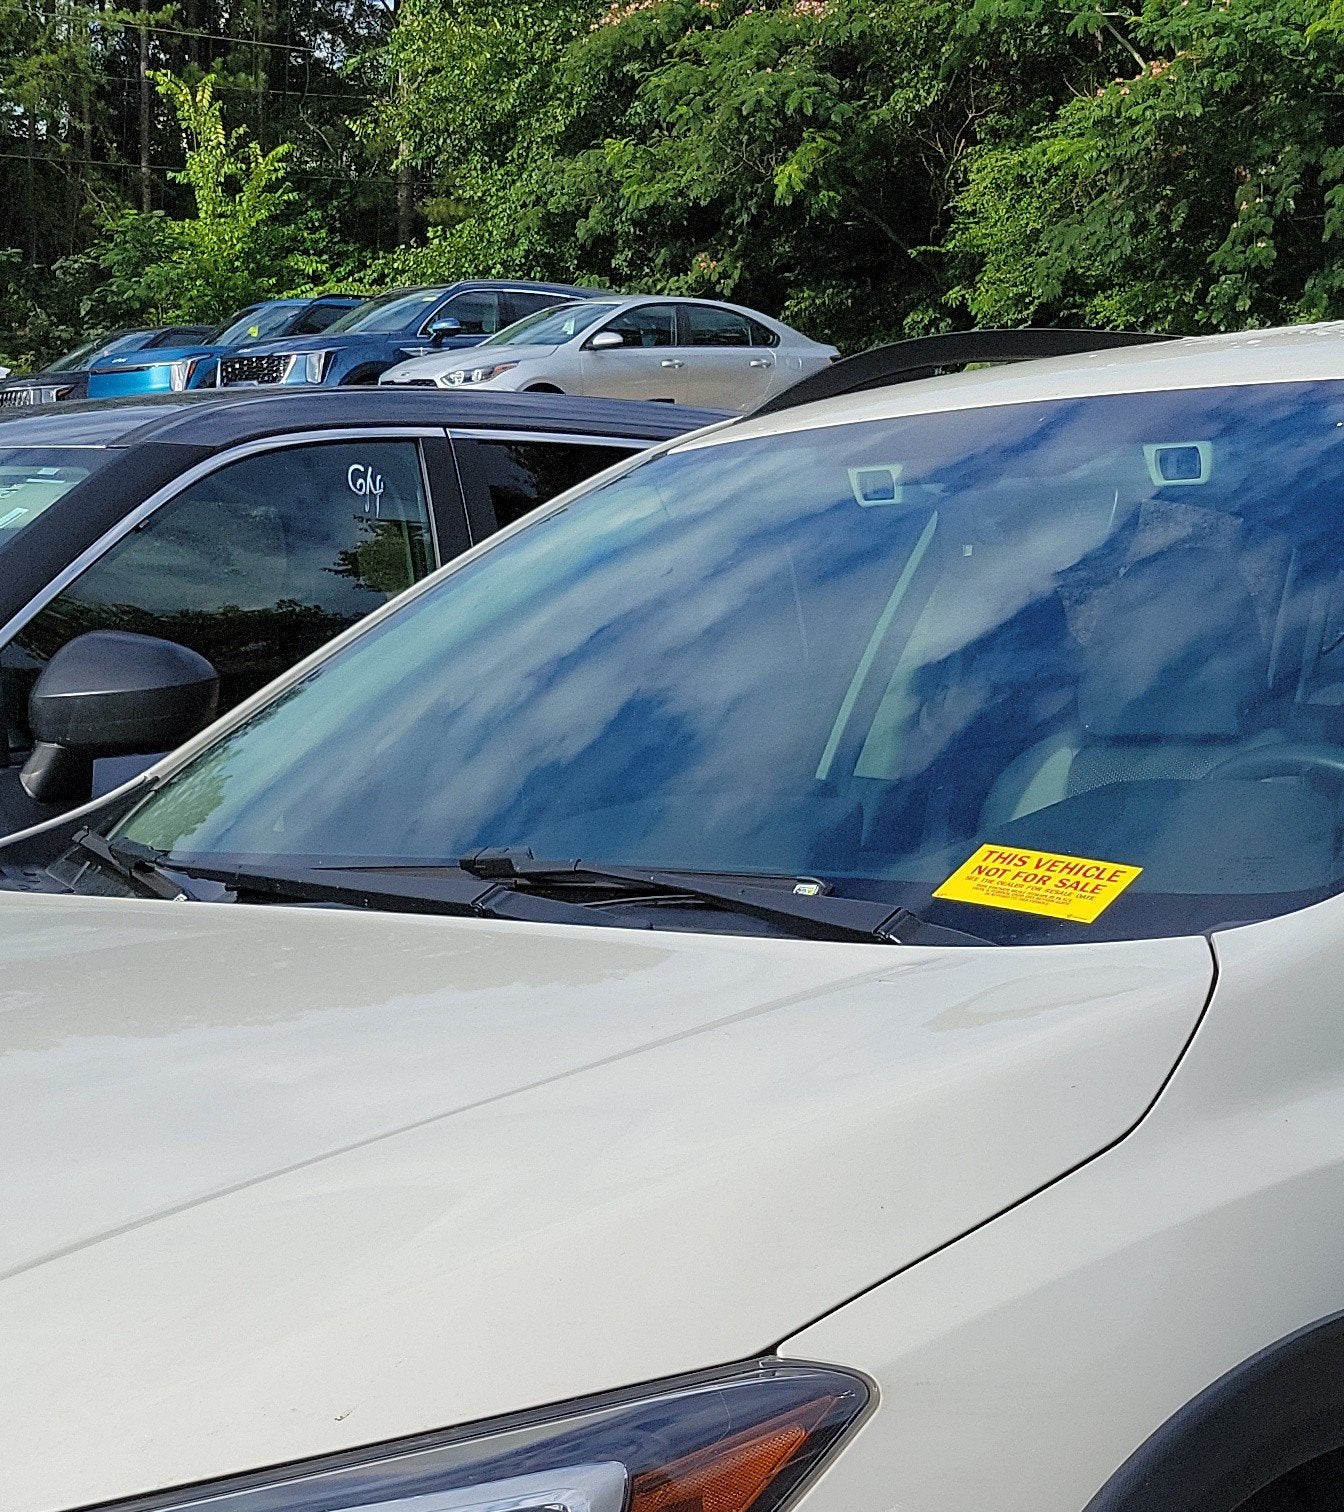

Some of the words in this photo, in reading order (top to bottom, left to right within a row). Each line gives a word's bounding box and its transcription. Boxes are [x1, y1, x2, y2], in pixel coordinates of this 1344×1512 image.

[971, 865, 1011, 879] NOT
[1011, 871, 1052, 886] FOR
[1054, 878, 1107, 895] SALE
[982, 850, 1031, 867] THIS
[1034, 857, 1127, 883] VEHICLE
[981, 877, 994, 885] THE
[996, 880, 1025, 890] DEALER
[1044, 888, 1073, 898] RESALE
[1075, 893, 1096, 902] DATE
